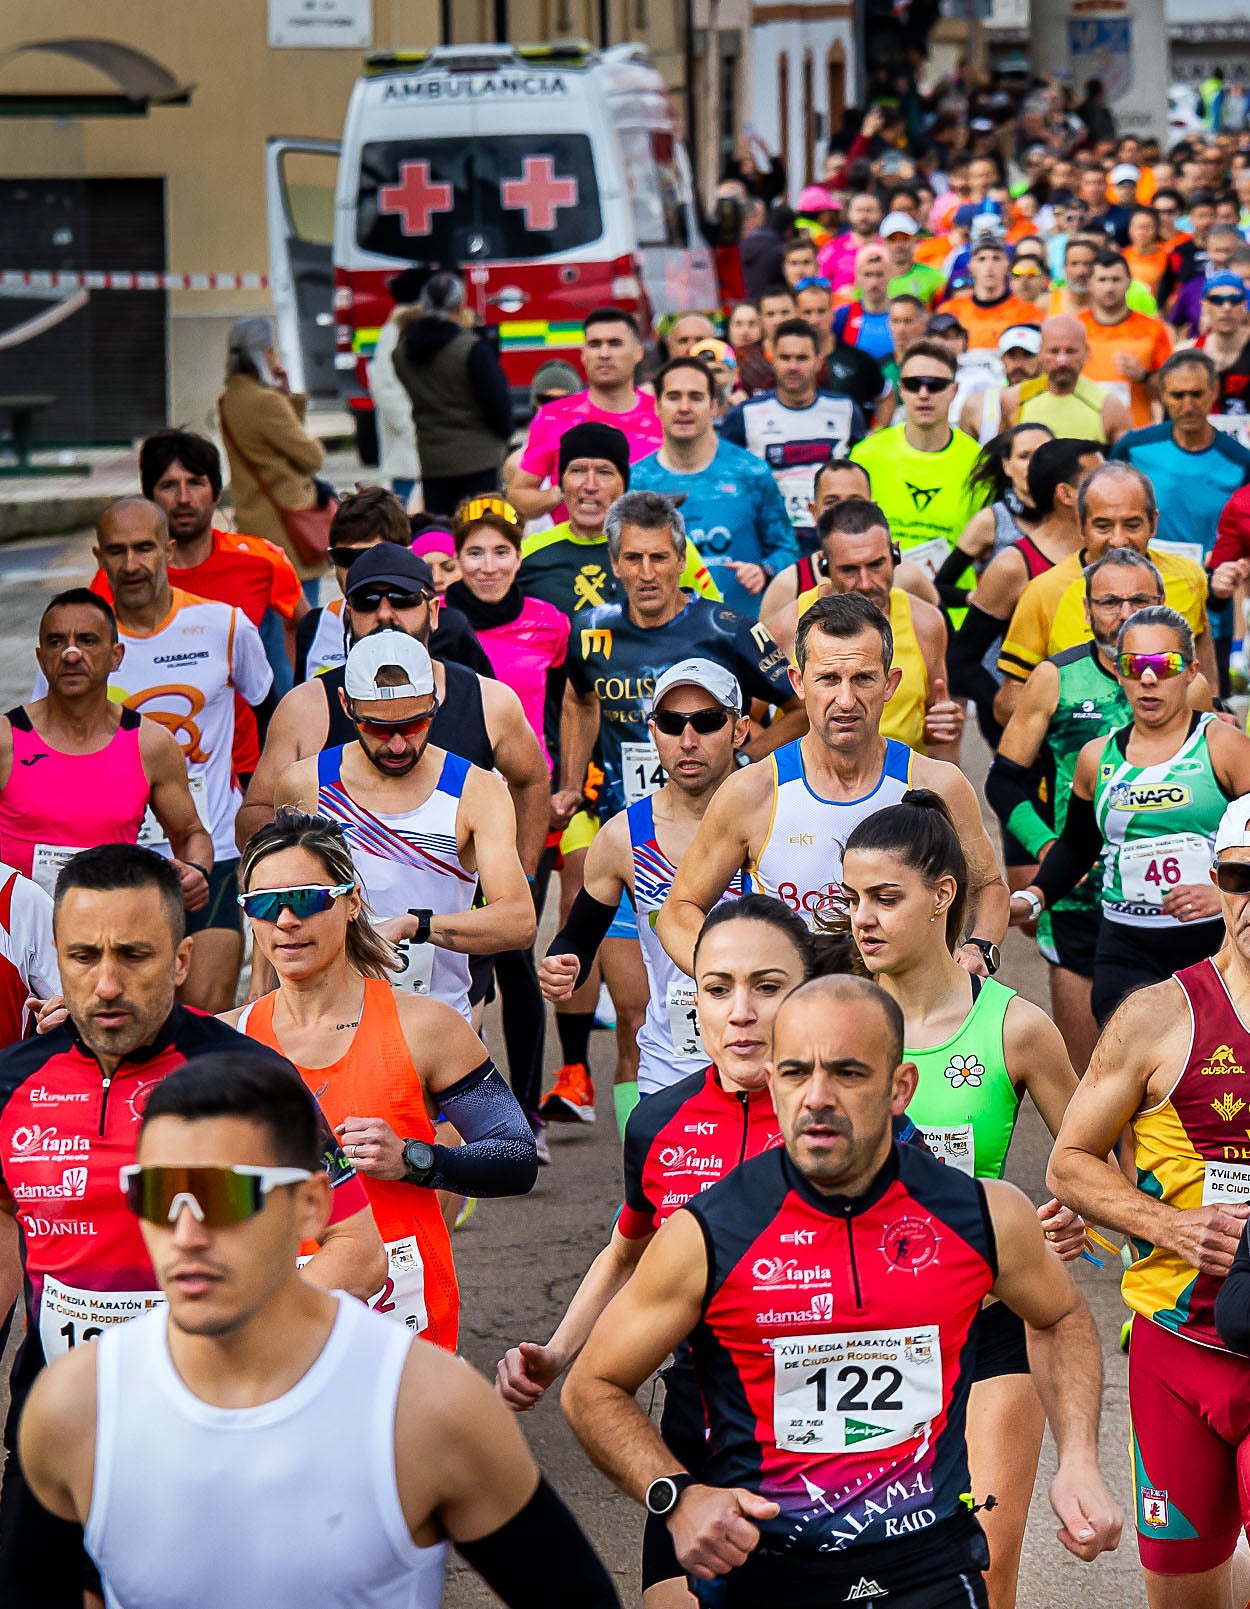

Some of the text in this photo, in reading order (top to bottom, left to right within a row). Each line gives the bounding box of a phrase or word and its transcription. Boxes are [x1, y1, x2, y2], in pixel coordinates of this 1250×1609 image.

[382, 76, 569, 102] AMBULANCIA
[594, 678, 656, 700] COLIS
[603, 709, 648, 723] PECT
[1144, 857, 1182, 887] 46
[42, 1135, 90, 1154] tapia
[685, 1154, 723, 1171] tapia
[1211, 1182, 1224, 1191] DE
[786, 1265, 831, 1284] tapia
[60, 1293, 87, 1307] MEDIA
[90, 1299, 141, 1310] MARATÓN
[56, 1305, 87, 1320] CIUDAD
[755, 1308, 814, 1324] adamas
[780, 1337, 901, 1356] XVII MEDIA MARATÓN
[784, 1351, 898, 1369] DE CIUDAD RODRIGO
[806, 1364, 903, 1412] 122
[885, 1508, 937, 1538] RAID
